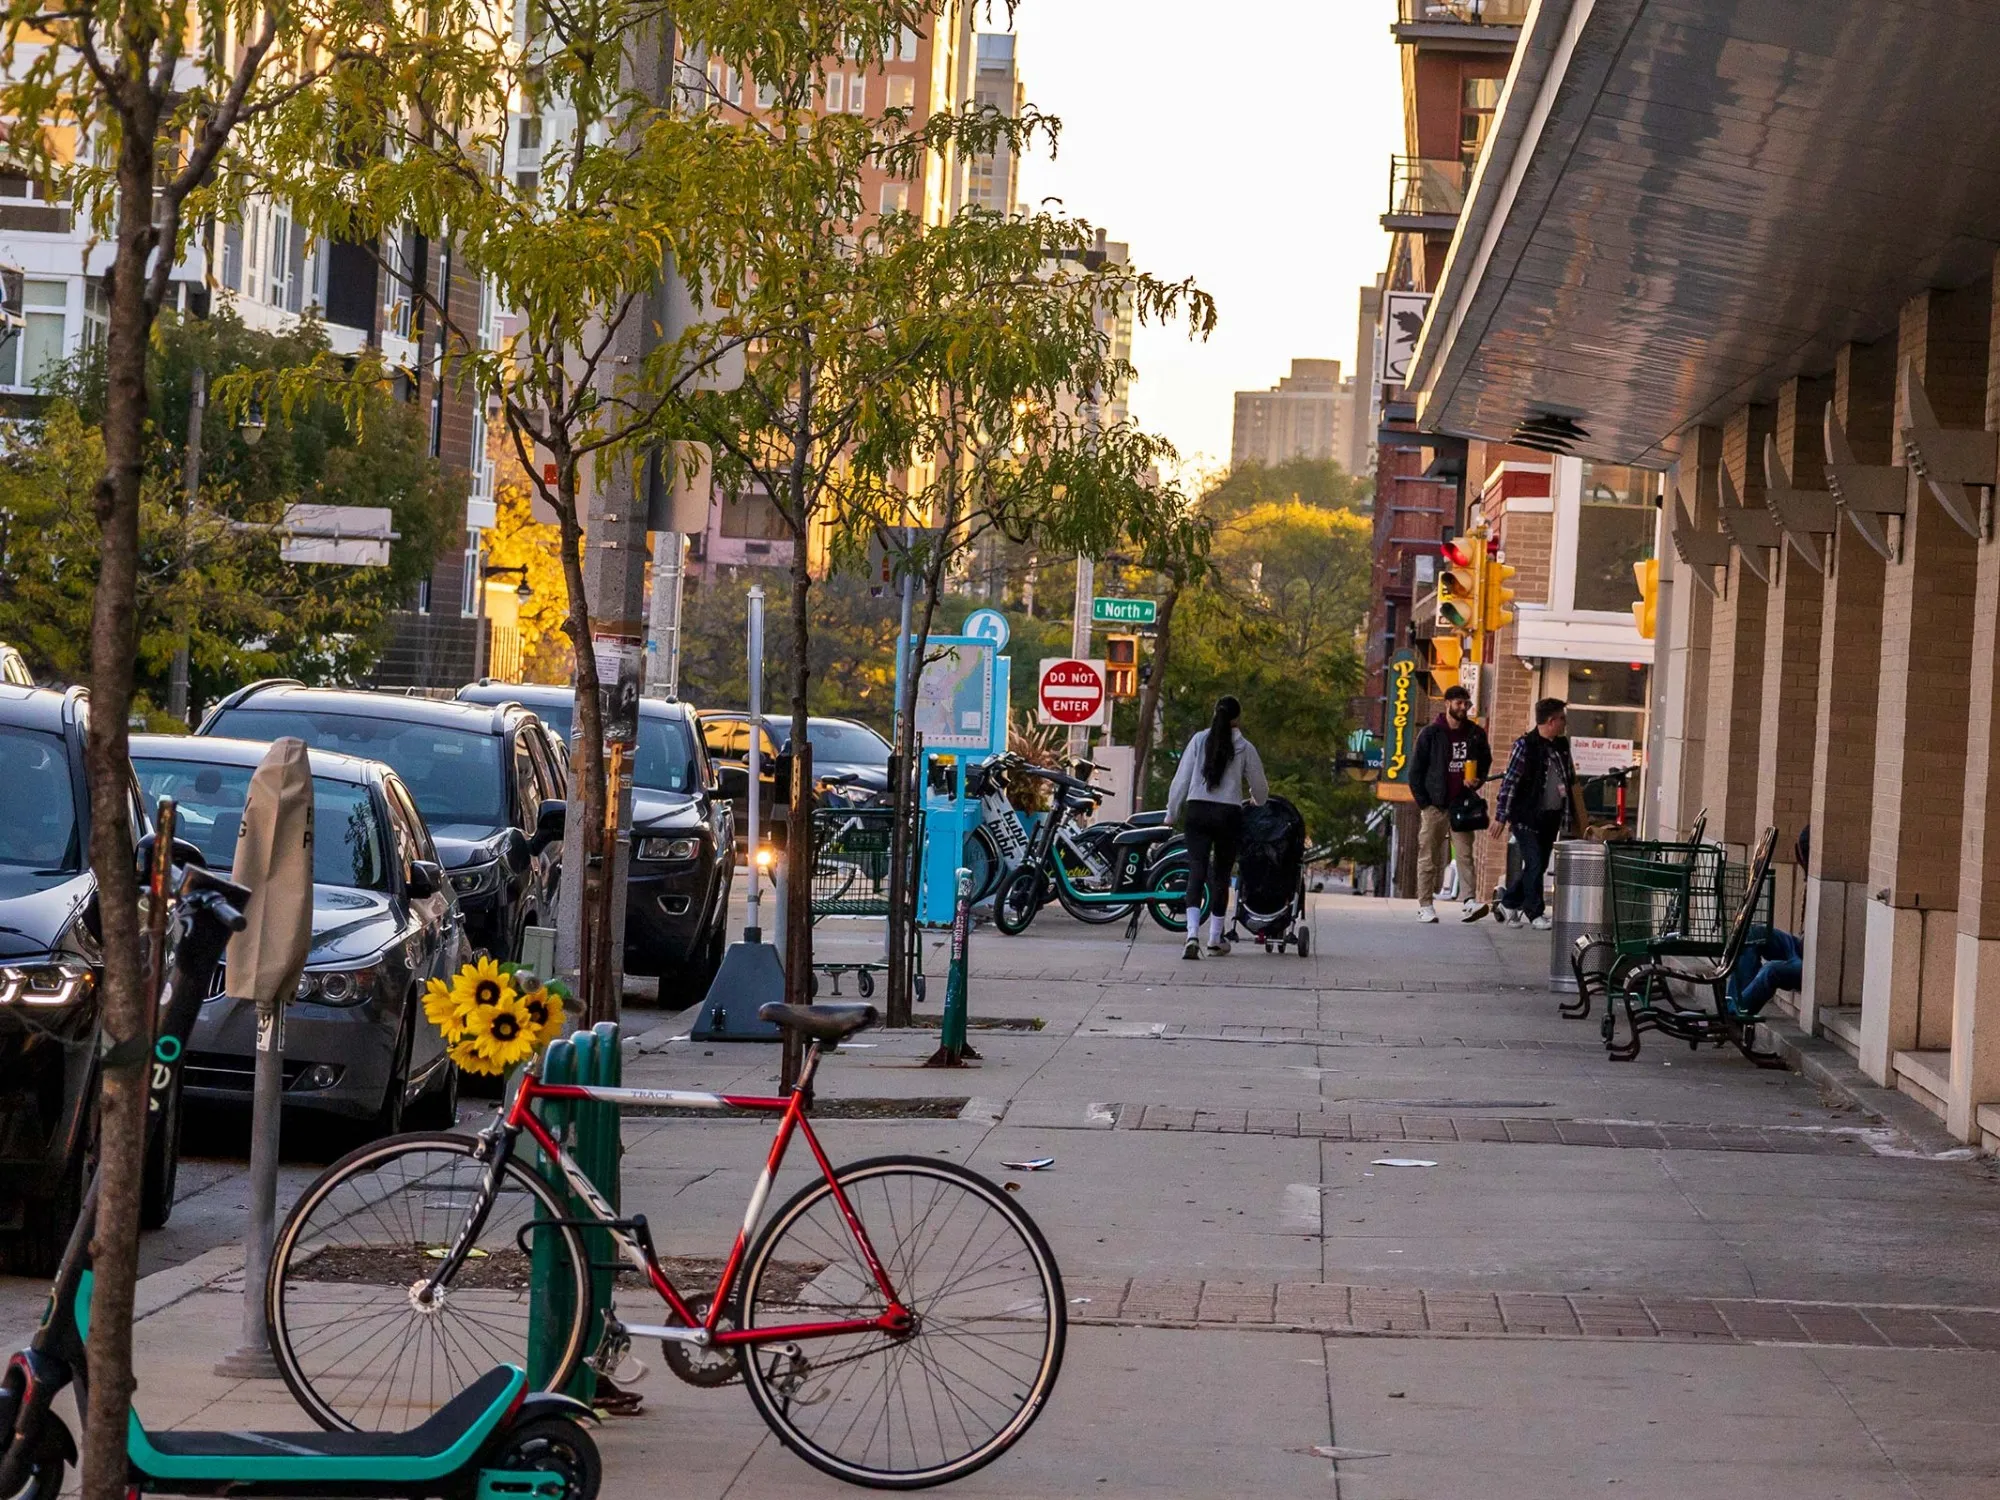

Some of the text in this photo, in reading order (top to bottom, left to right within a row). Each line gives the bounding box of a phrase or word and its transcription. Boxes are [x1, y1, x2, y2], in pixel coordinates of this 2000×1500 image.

[1105, 602, 1140, 619] North
[1050, 671, 1095, 684] DO NOT
[1053, 700, 1089, 711] ENTER
[1387, 661, 1415, 779] Potbelly
[1575, 740, 1630, 750] Join Our Team!
[988, 820, 1015, 859] bublr
[1122, 852, 1140, 885] veo
[630, 1090, 675, 1100] TRACK
